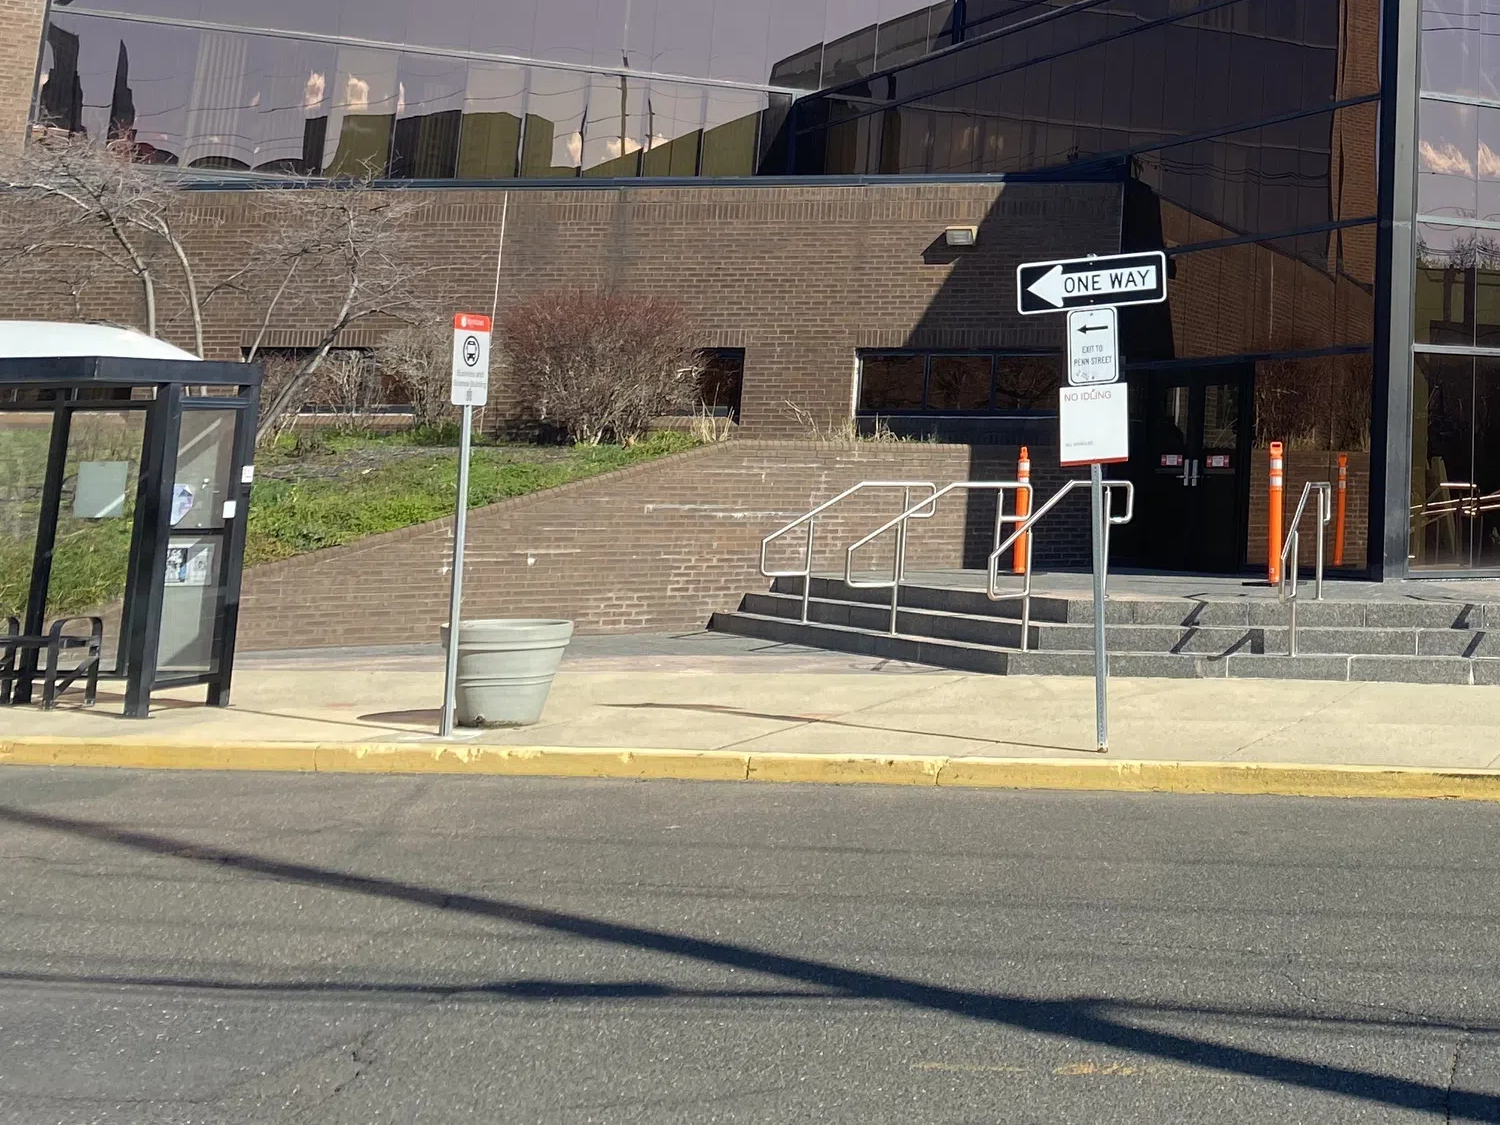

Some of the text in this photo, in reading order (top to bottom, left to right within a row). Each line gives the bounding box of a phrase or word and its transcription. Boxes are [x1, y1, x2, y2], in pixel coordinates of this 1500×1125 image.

[1064, 269, 1150, 293] ONE WAY
[1082, 344, 1103, 353] EXIT TO
[1073, 356, 1112, 367] PENN STREET
[1064, 390, 1112, 402] NO IDLING
